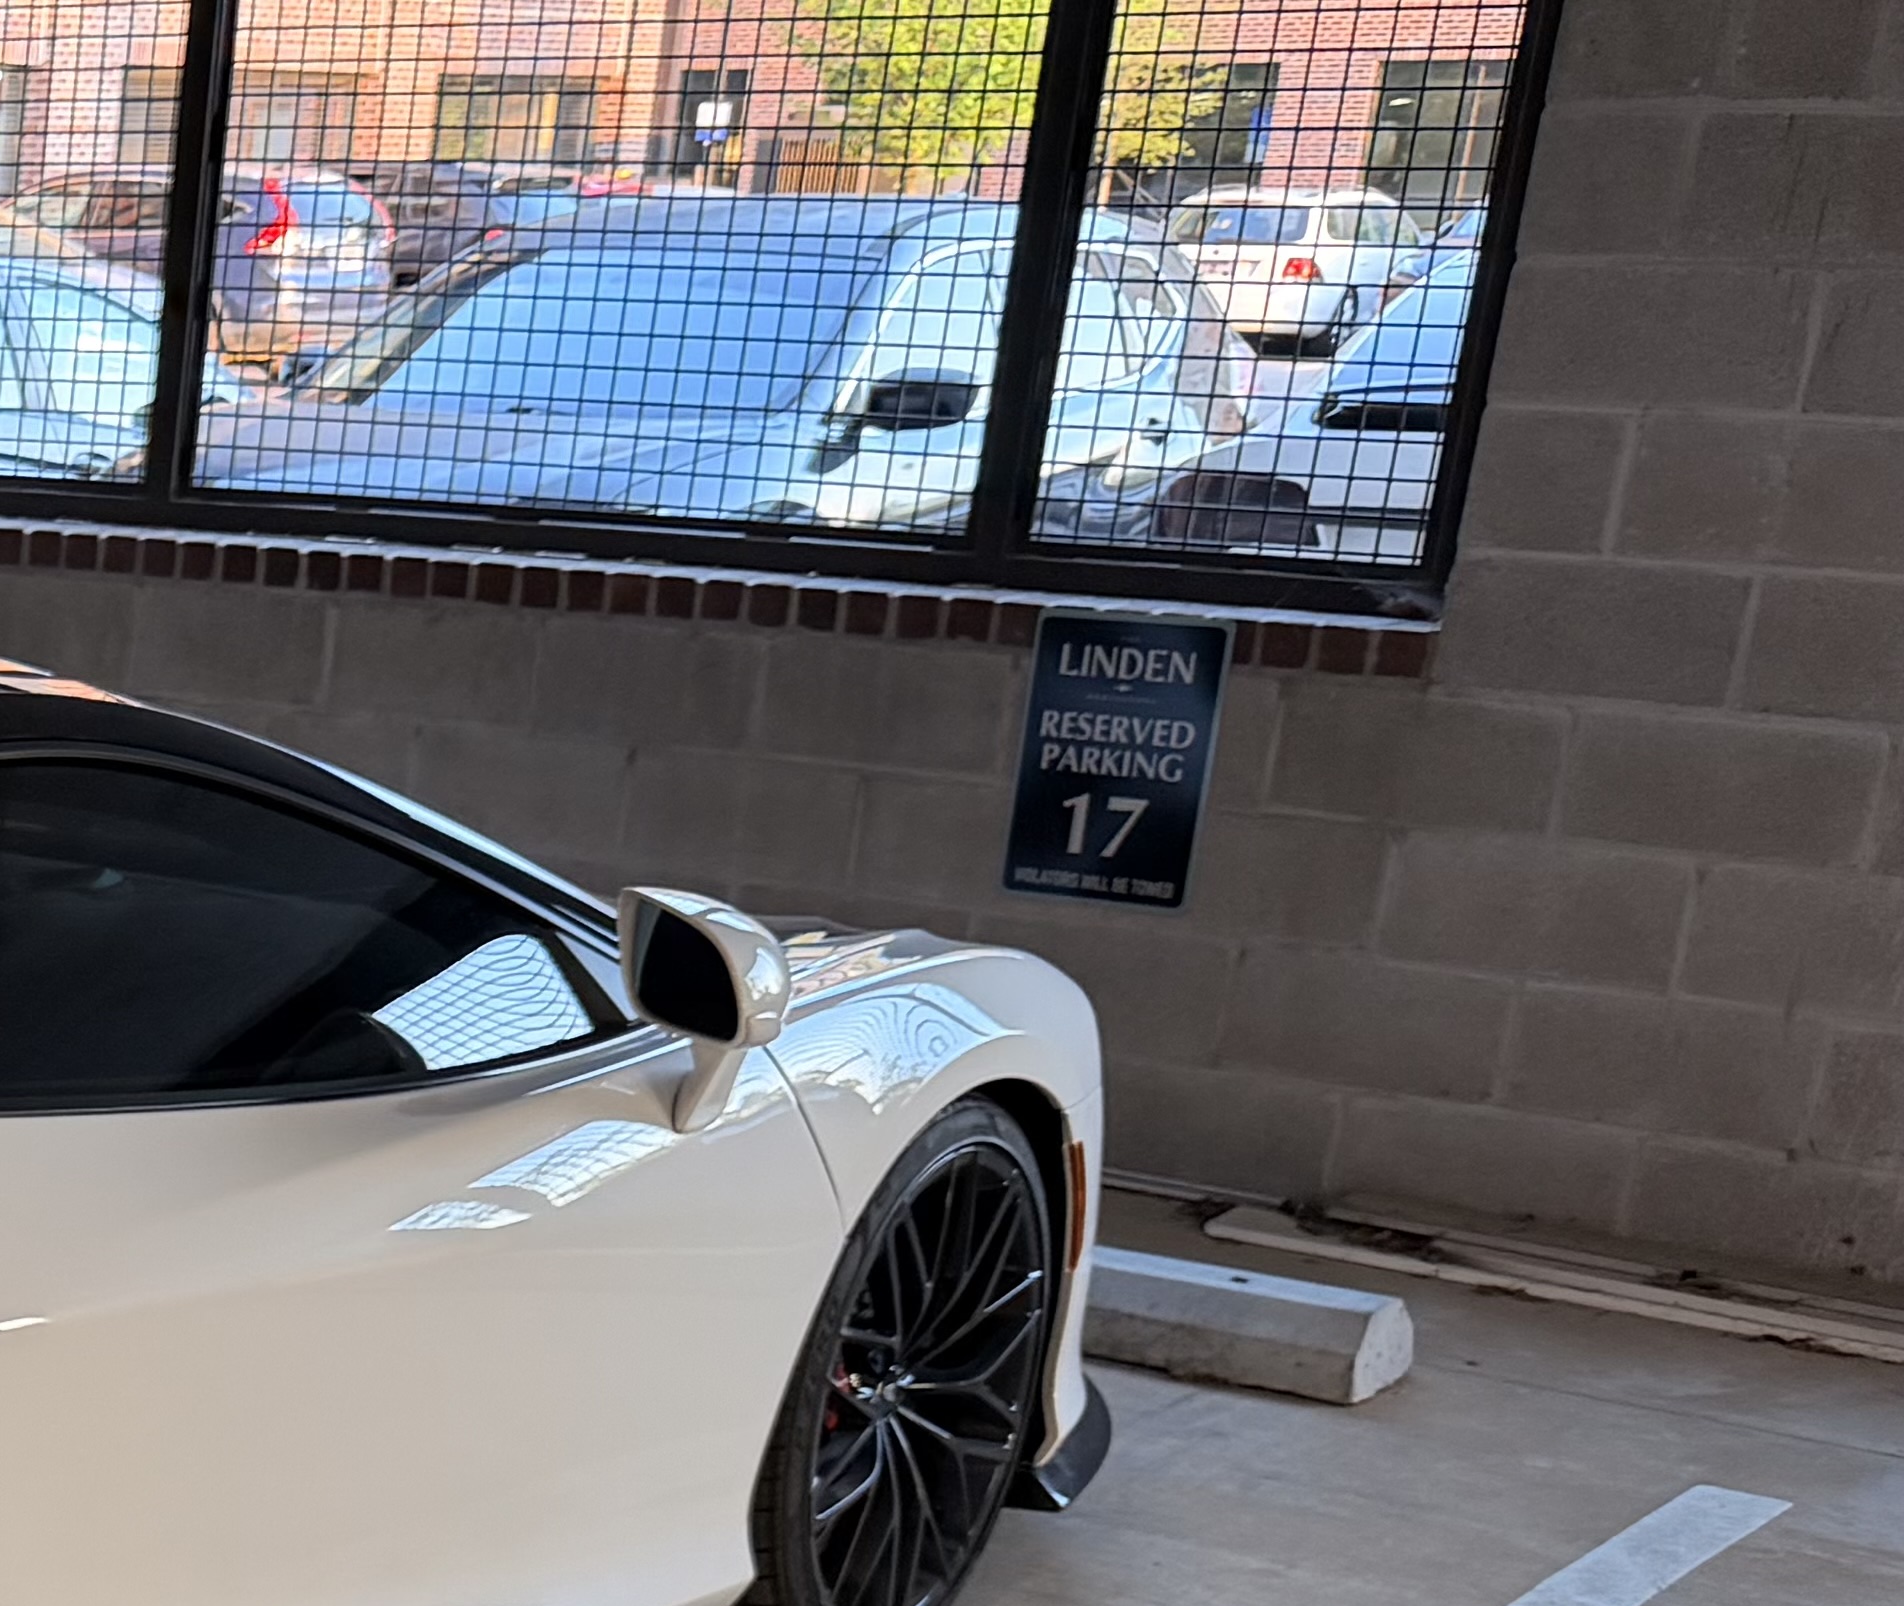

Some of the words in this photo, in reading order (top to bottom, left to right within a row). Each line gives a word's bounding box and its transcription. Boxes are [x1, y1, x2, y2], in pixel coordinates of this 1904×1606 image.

[1058, 643, 1197, 684] LINDEN
[1039, 709, 1195, 749] RESERVED
[1040, 743, 1185, 783] PARKING
[1062, 792, 1150, 858] 17
